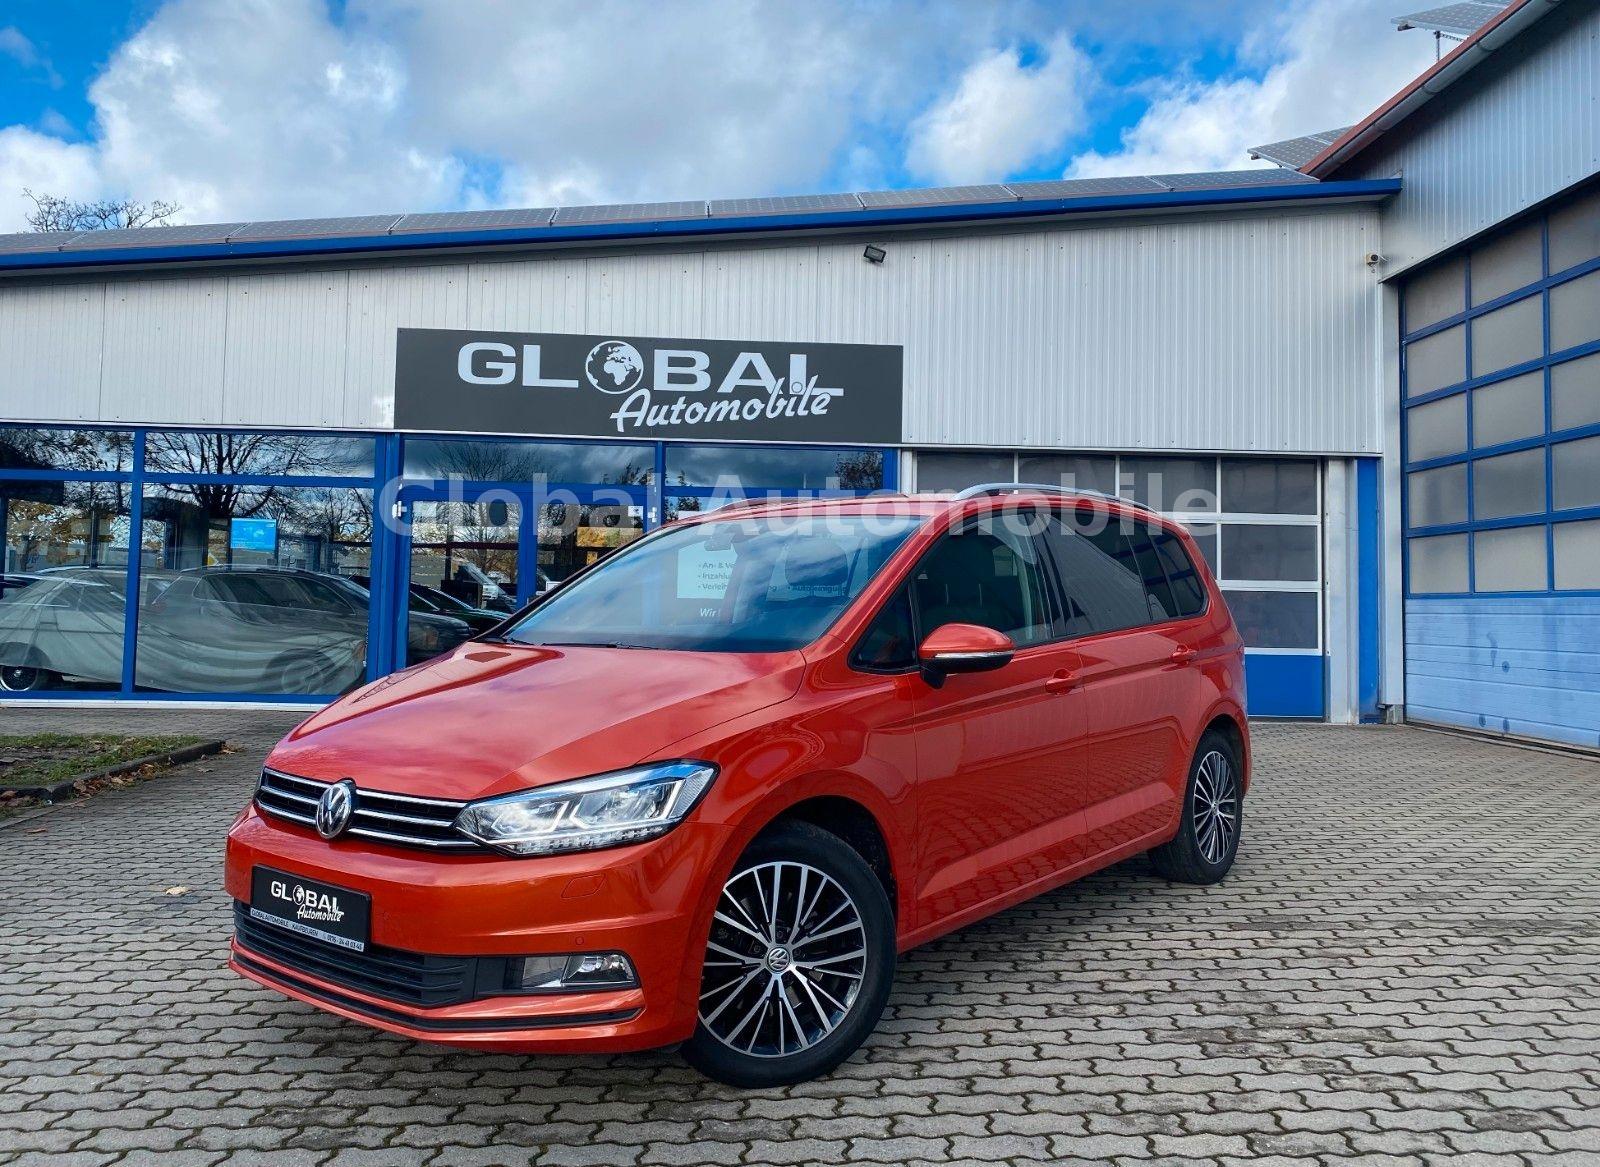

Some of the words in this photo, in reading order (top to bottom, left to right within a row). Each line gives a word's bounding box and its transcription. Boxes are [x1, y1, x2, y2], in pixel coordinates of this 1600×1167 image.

[457, 340, 845, 398] GLOBAL
[609, 375, 832, 433] Automobile
[700, 608, 717, 617] Wir
[271, 881, 344, 915] GLOBAL
[297, 904, 344, 921] Automobile
